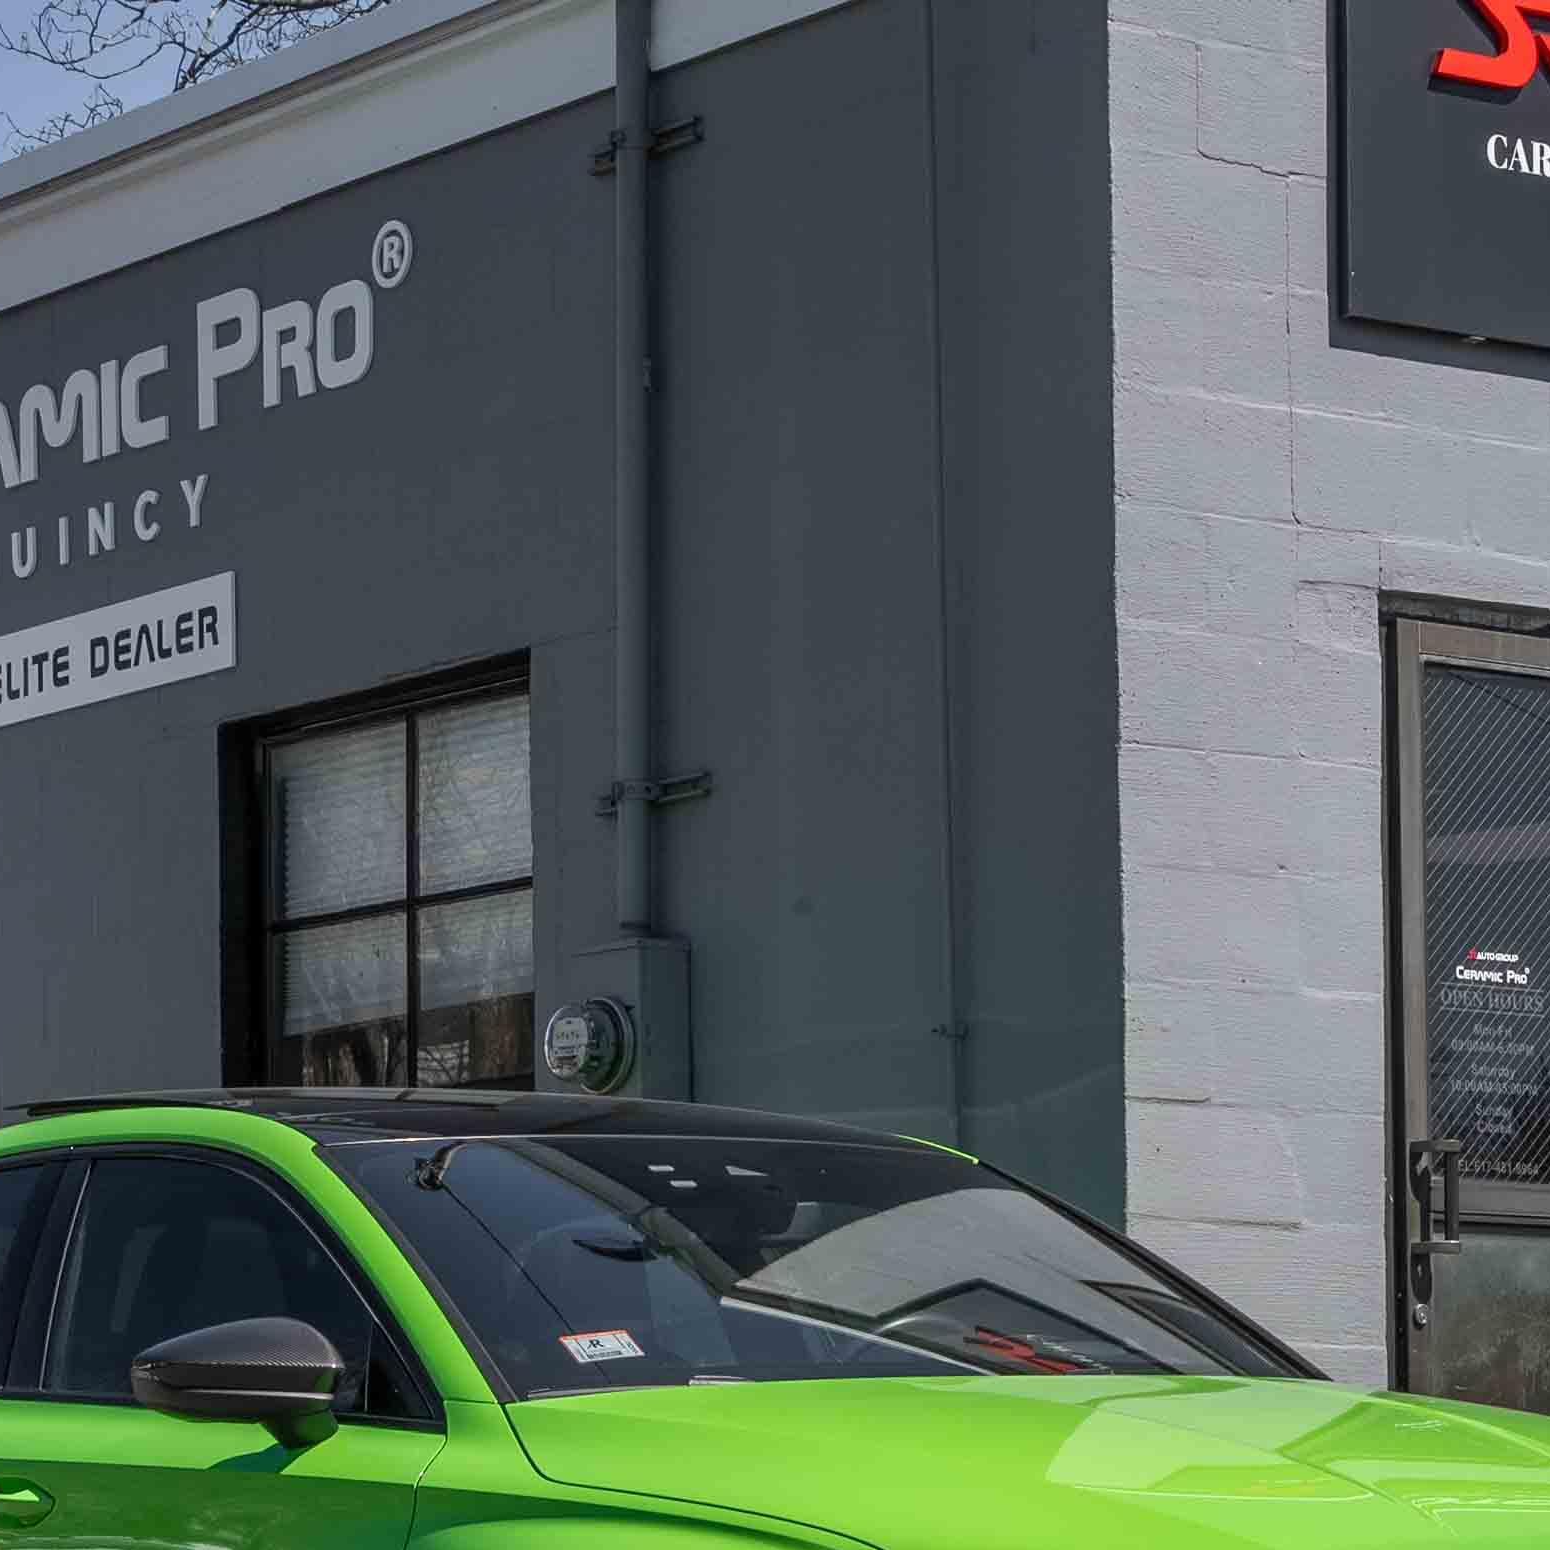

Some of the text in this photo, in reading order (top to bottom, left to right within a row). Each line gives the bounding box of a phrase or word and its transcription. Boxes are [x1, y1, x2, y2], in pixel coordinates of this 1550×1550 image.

[90, 605, 220, 679] DEALER
[1455, 965, 1503, 984] CERAMIC
[1489, 992, 1545, 1013] HOURS
